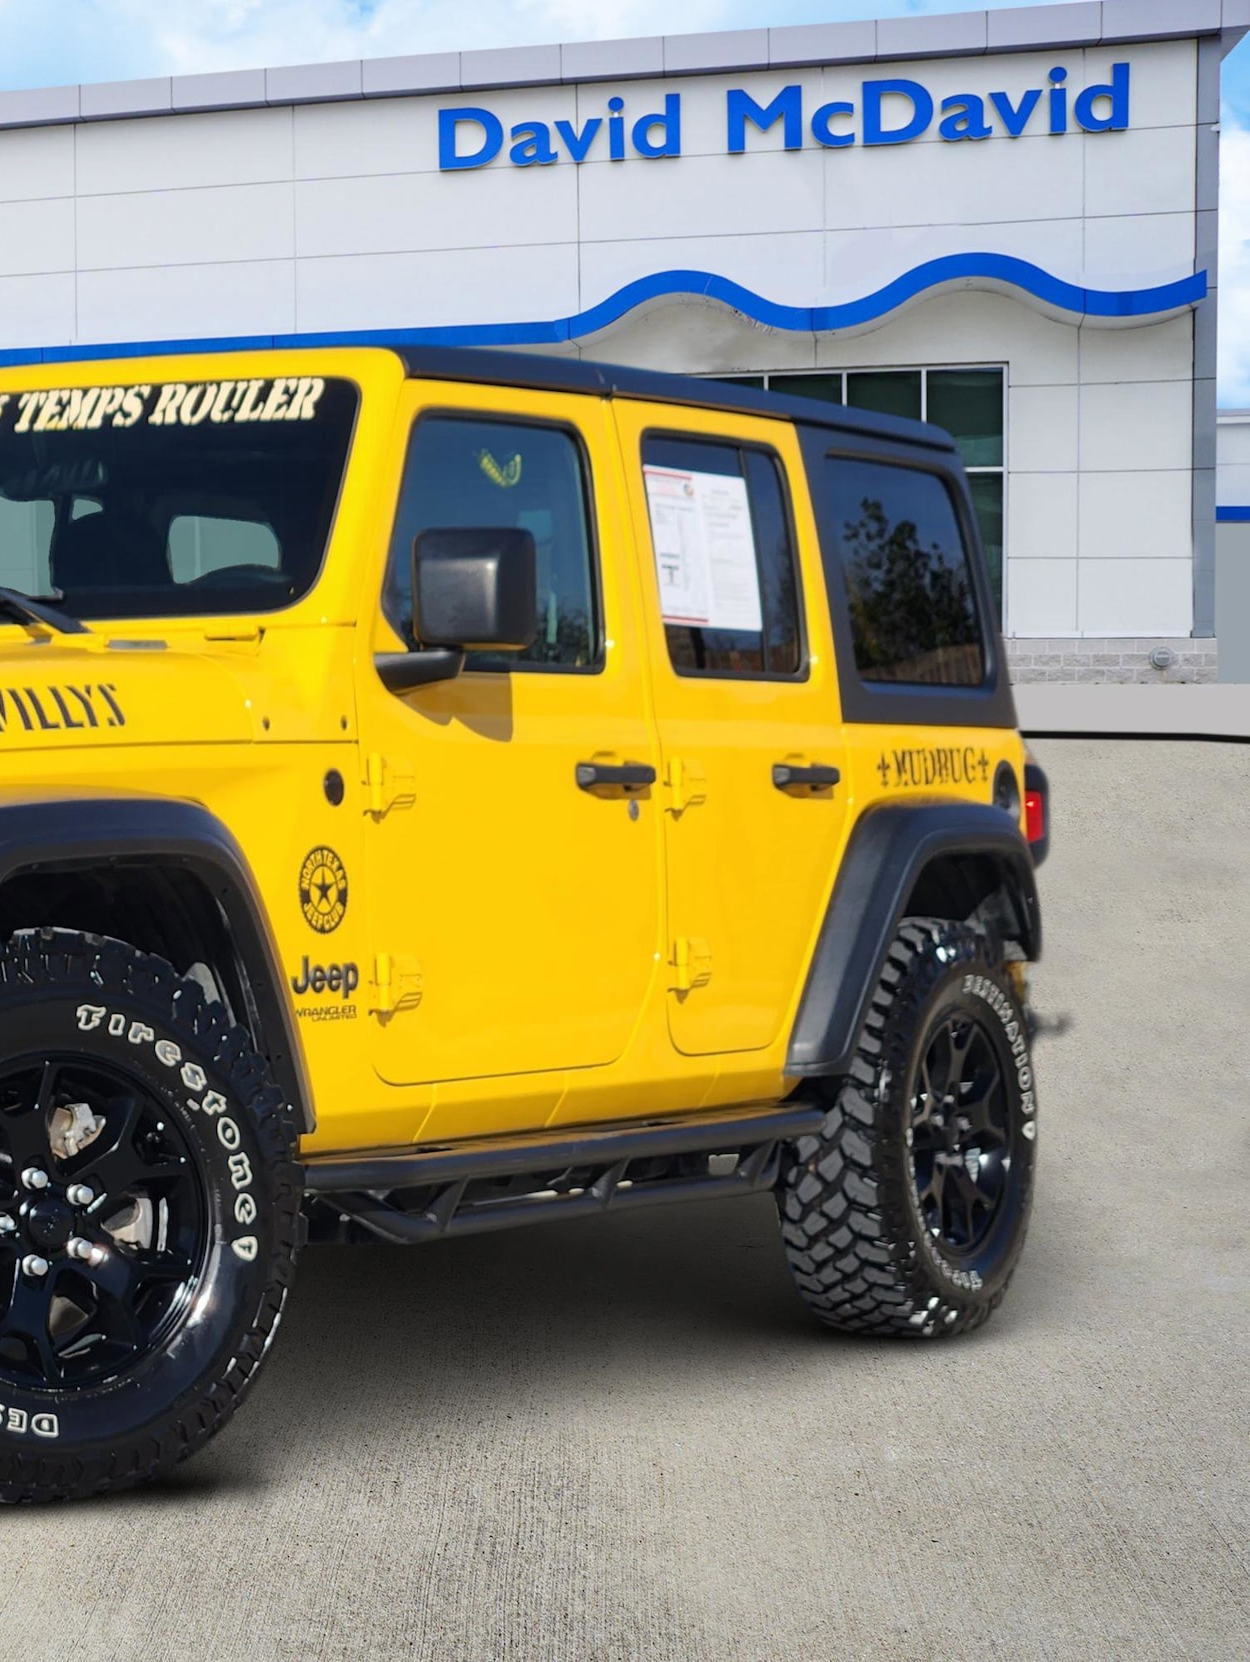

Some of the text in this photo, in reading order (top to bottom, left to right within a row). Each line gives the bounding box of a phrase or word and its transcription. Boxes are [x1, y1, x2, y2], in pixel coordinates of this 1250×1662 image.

[438, 62, 1131, 172] David McDavid
[14, 384, 152, 433] TEMPS
[147, 377, 324, 426] ROULER
[291, 955, 359, 999] Jeep
[295, 1004, 357, 1018] WRANGLER
